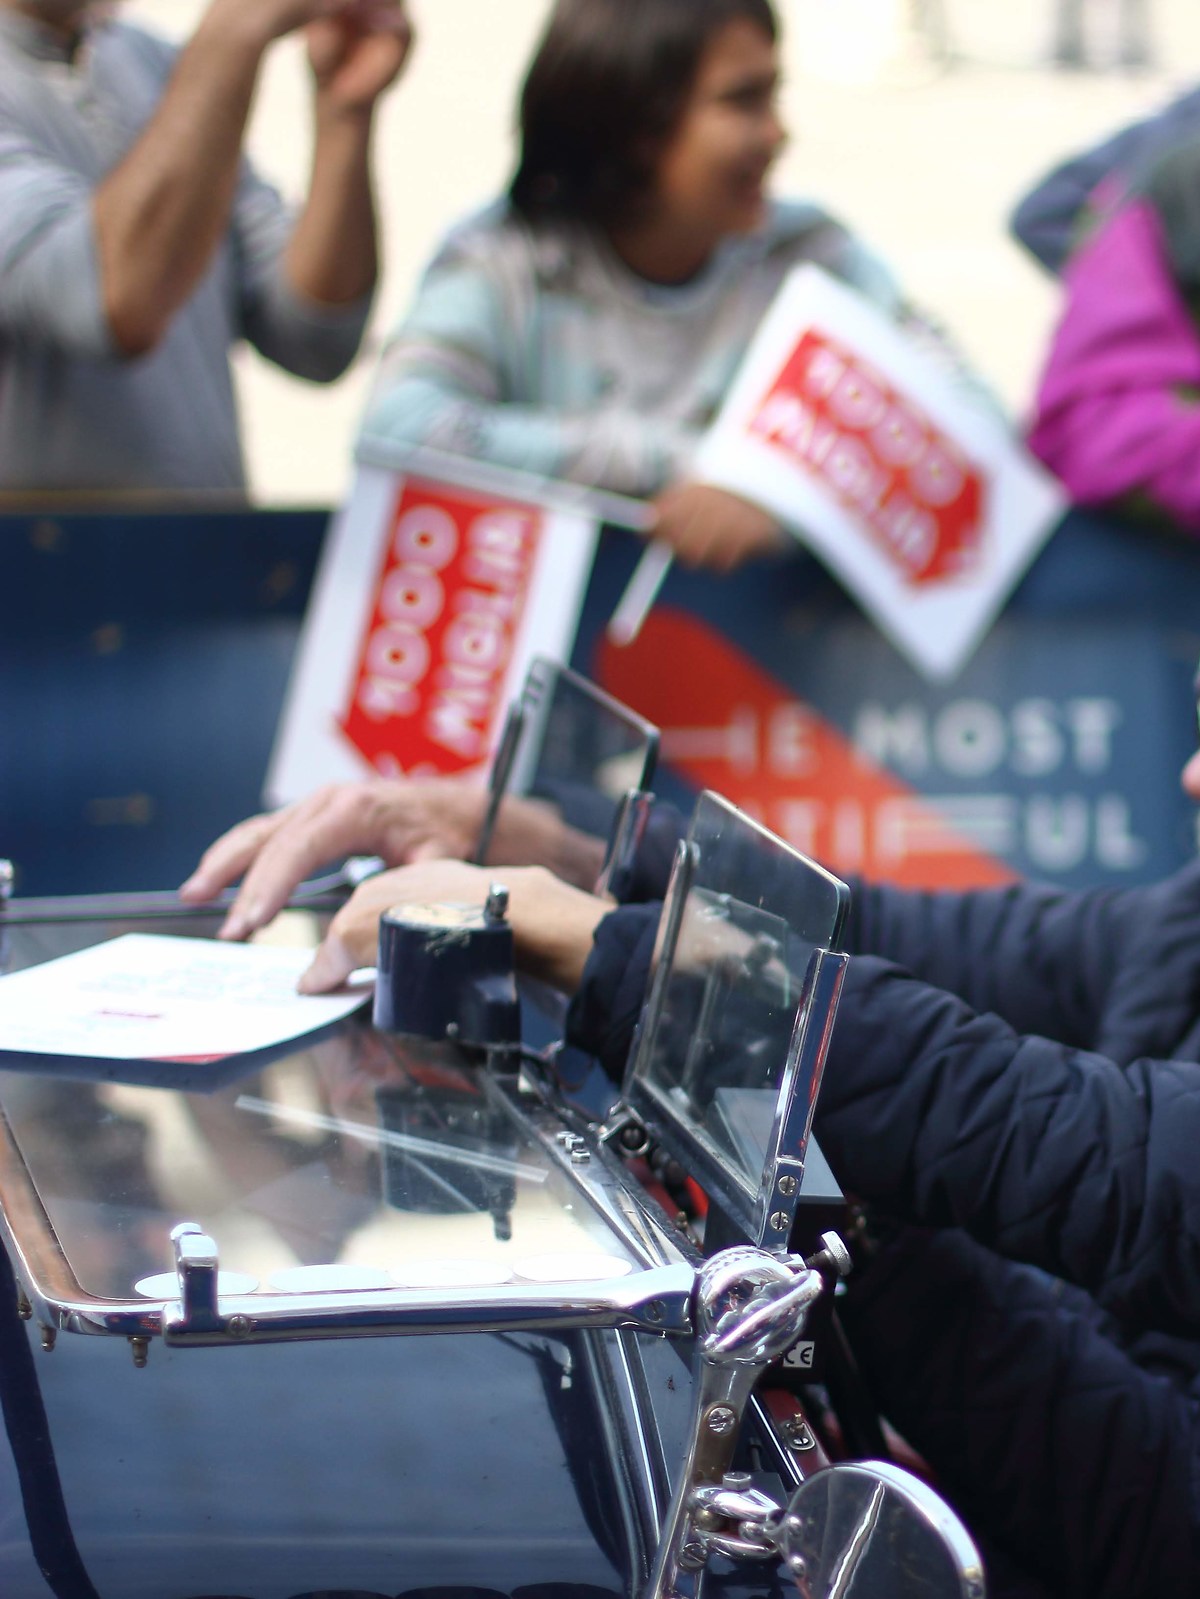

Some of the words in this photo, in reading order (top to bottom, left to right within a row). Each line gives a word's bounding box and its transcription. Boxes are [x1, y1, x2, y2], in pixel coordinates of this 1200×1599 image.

[750, 392, 941, 570] MIGLIA
[803, 348, 966, 507] 1000
[356, 503, 459, 722] 1000
[424, 508, 536, 758] MIGLIA
[854, 700, 1120, 778] MOST
